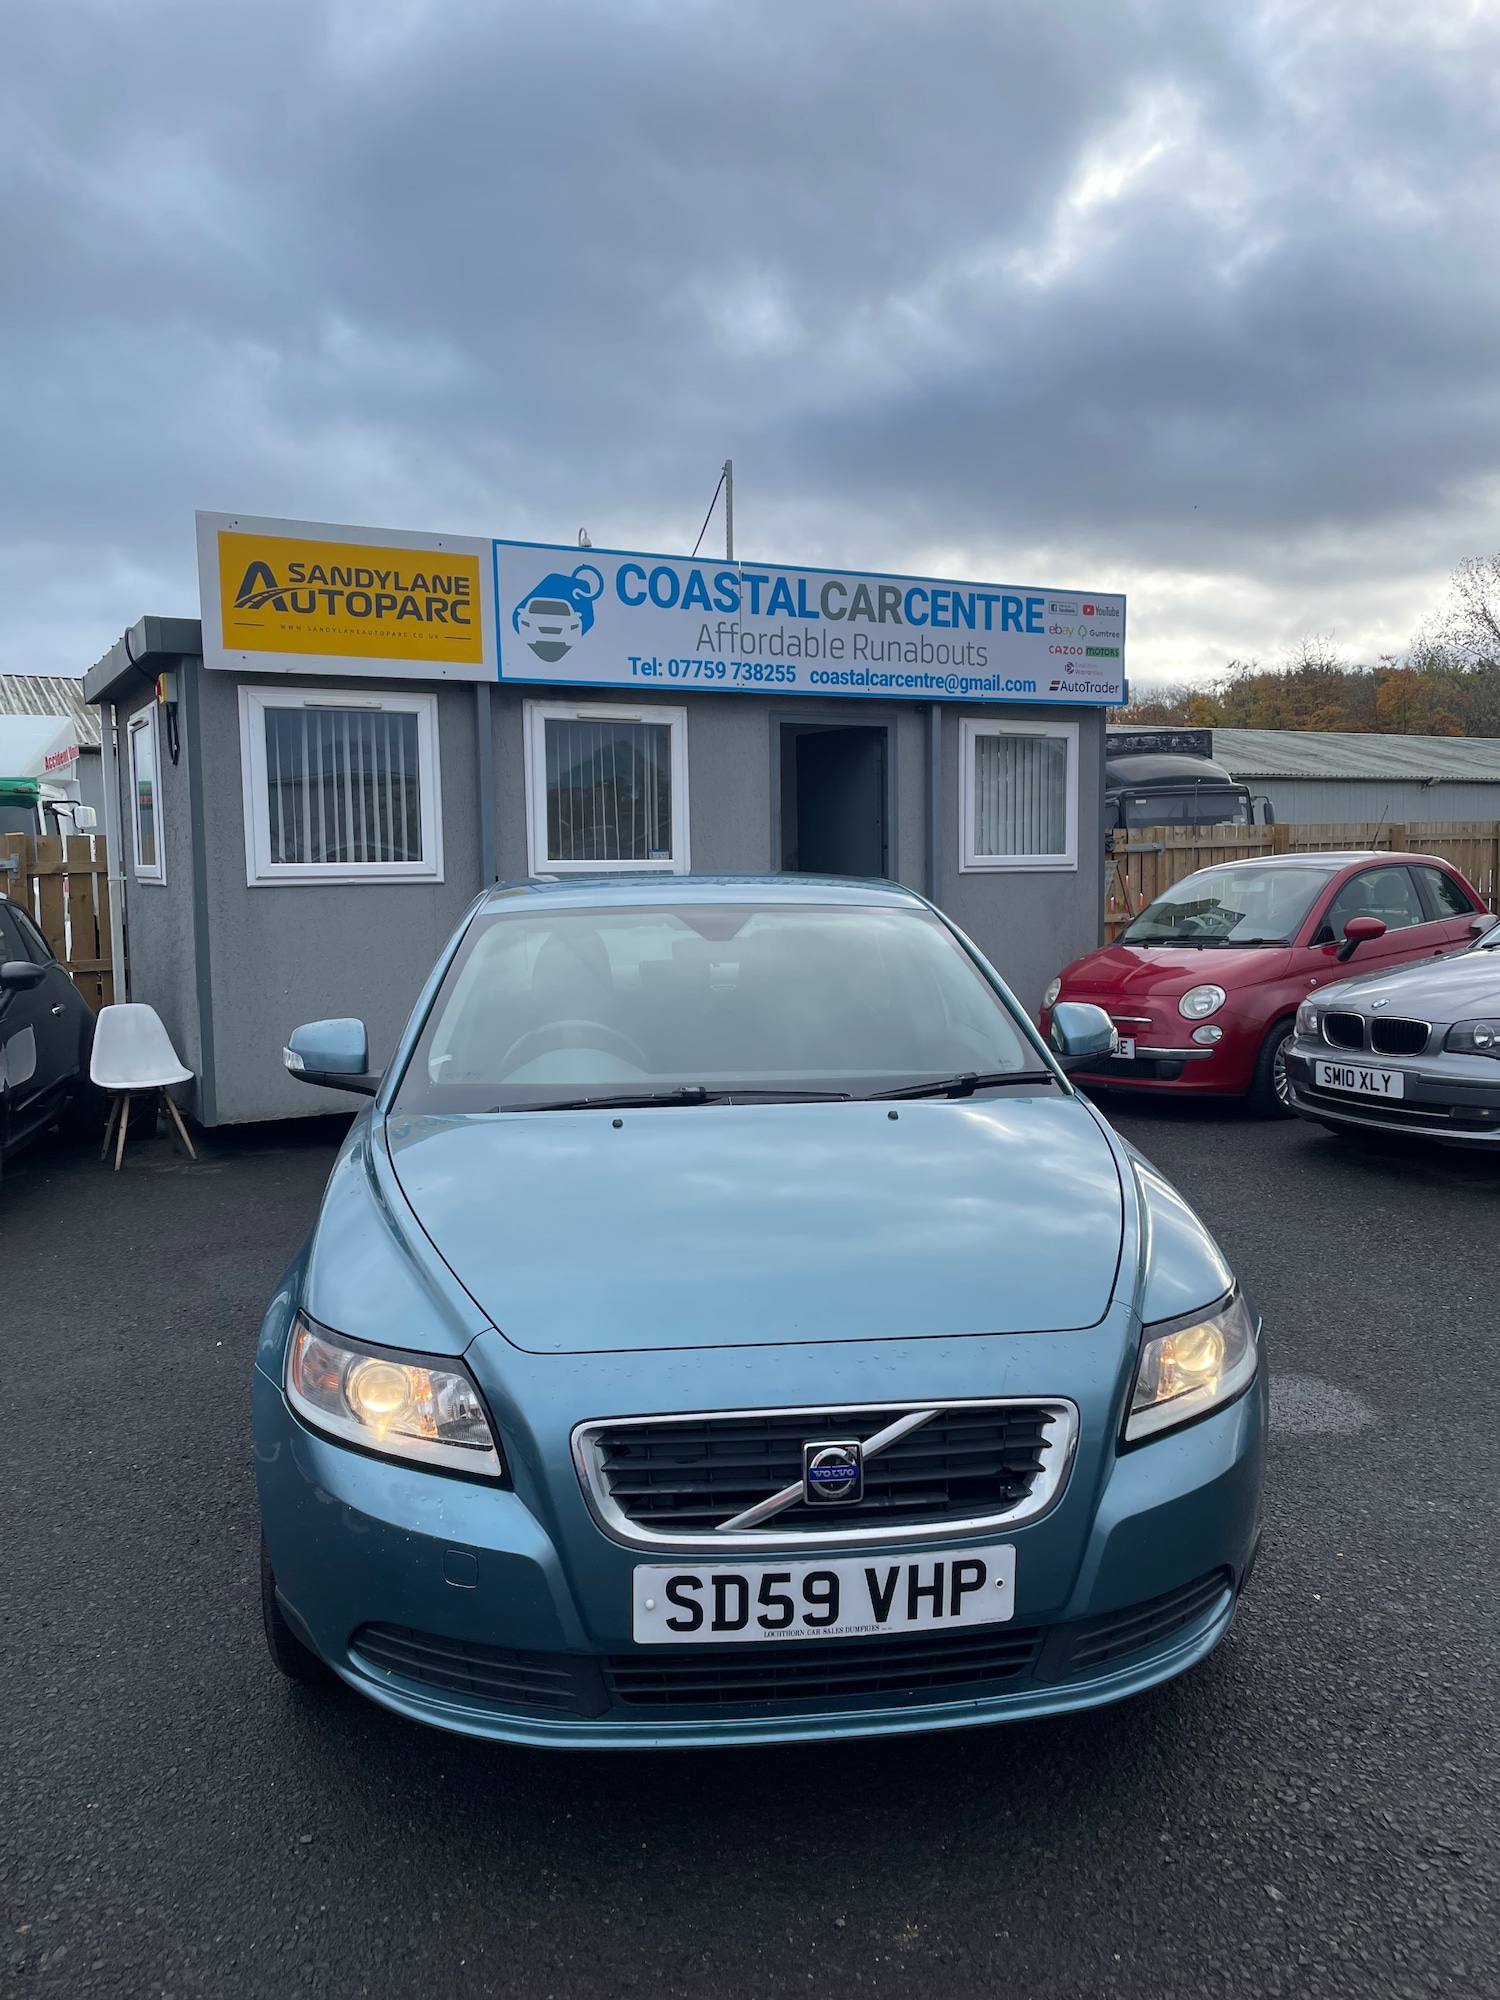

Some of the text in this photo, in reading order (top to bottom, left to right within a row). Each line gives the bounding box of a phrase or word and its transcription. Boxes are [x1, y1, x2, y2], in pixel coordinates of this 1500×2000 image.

[288, 562, 470, 597] SANDYLANE
[233, 560, 471, 625] AUTOPARC
[1096, 605, 1119, 617] YouTube
[1049, 623, 1074, 637] ebay
[1090, 629, 1120, 638] Gumtree
[696, 621, 988, 667] Affordable Runabouts
[1049, 645, 1083, 655] CAZOO
[628, 656, 796, 683] Tel: 07759 738255
[810, 667, 1037, 694] coastalcarcentre@gmail.com
[1060, 680, 1120, 694] AutoTrader
[1360, 1071, 1391, 1093] XLY
[813, 1468, 855, 1478] VOLVO
[665, 1558, 987, 1632] SD59 VHP
[764, 1629, 804, 1638] LOCHTHORN
[807, 1628, 820, 1636] CAR
[823, 1627, 843, 1635] SALES
[845, 1625, 879, 1633] DUMFRIES
